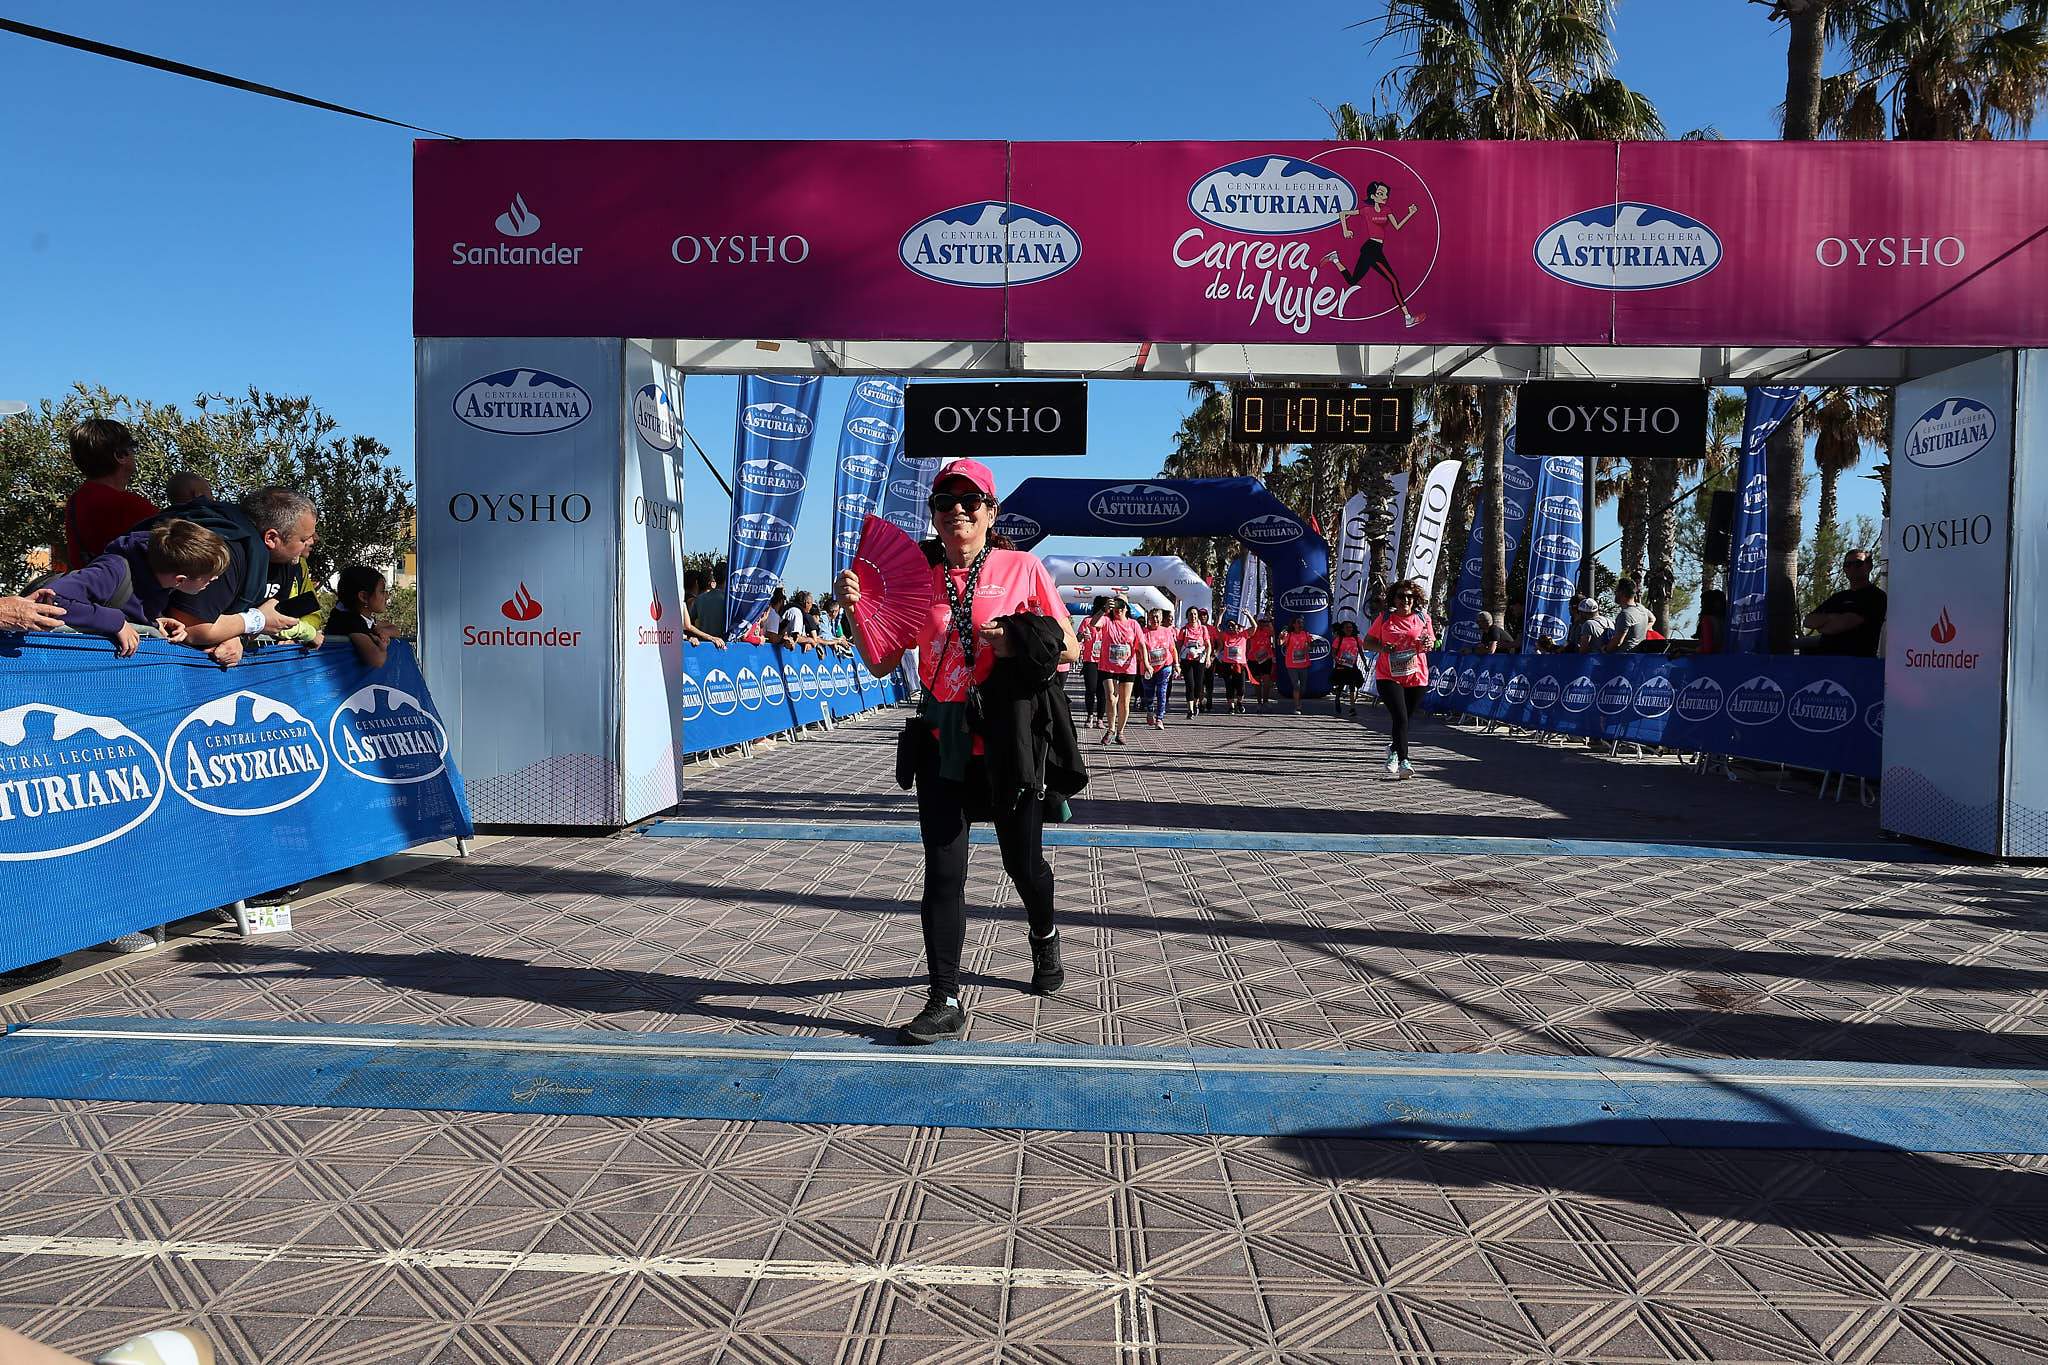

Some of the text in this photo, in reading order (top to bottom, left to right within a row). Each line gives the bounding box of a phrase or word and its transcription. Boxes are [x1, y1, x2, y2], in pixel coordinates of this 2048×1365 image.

[1200, 183, 1343, 214] ASTURIANA
[1227, 183, 1339, 191] CENTRAL LECHERA
[912, 233, 1068, 265] ASTURIANA
[941, 231, 998, 240] CENTRAL
[1577, 232, 1702, 241] CENTRAL LECHERA
[452, 242, 583, 265] Santander
[671, 235, 810, 264] OYSHO
[1172, 228, 1310, 271] Carrera
[1548, 234, 1707, 267] ASTURIANA
[1815, 236, 1966, 268] OYSHO
[1205, 267, 1361, 335] de la Mujer
[464, 392, 582, 419] ASTURIANA
[485, 391, 577, 399] CENTRAL LECHERA
[745, 411, 808, 435] ASTURIANA
[934, 406, 1061, 433] OYSHO
[1244, 398, 1399, 433] 01:04:57
[1547, 405, 1680, 434] OYSHO
[1922, 413, 1986, 434] CENTRAL LECHERA
[1910, 422, 1989, 457] ASTURIANA
[741, 467, 800, 489] ASTURIANA
[449, 493, 592, 523] OYSHO
[635, 496, 679, 534] OYSHO
[1096, 496, 1182, 516] ASTURIANA
[1243, 527, 1299, 538] ASTURIANA
[1410, 484, 1448, 581] YSHO
[1902, 514, 1992, 552] OYSHO
[1073, 561, 1153, 579] OYSHO
[463, 625, 582, 647] Santander
[638, 626, 674, 646] Santander
[1905, 649, 1980, 670] Santander
[1729, 694, 1779, 713] ASTURIANA
[1791, 698, 1847, 721] ASTURIANA
[205, 726, 307, 749] CENTRAL LECHERA
[342, 724, 438, 765] ASTURIAN
[0, 744, 137, 772] NTRAL LECHERA
[186, 740, 321, 791] ASTURIANA
[0, 764, 152, 821] TURIANA
